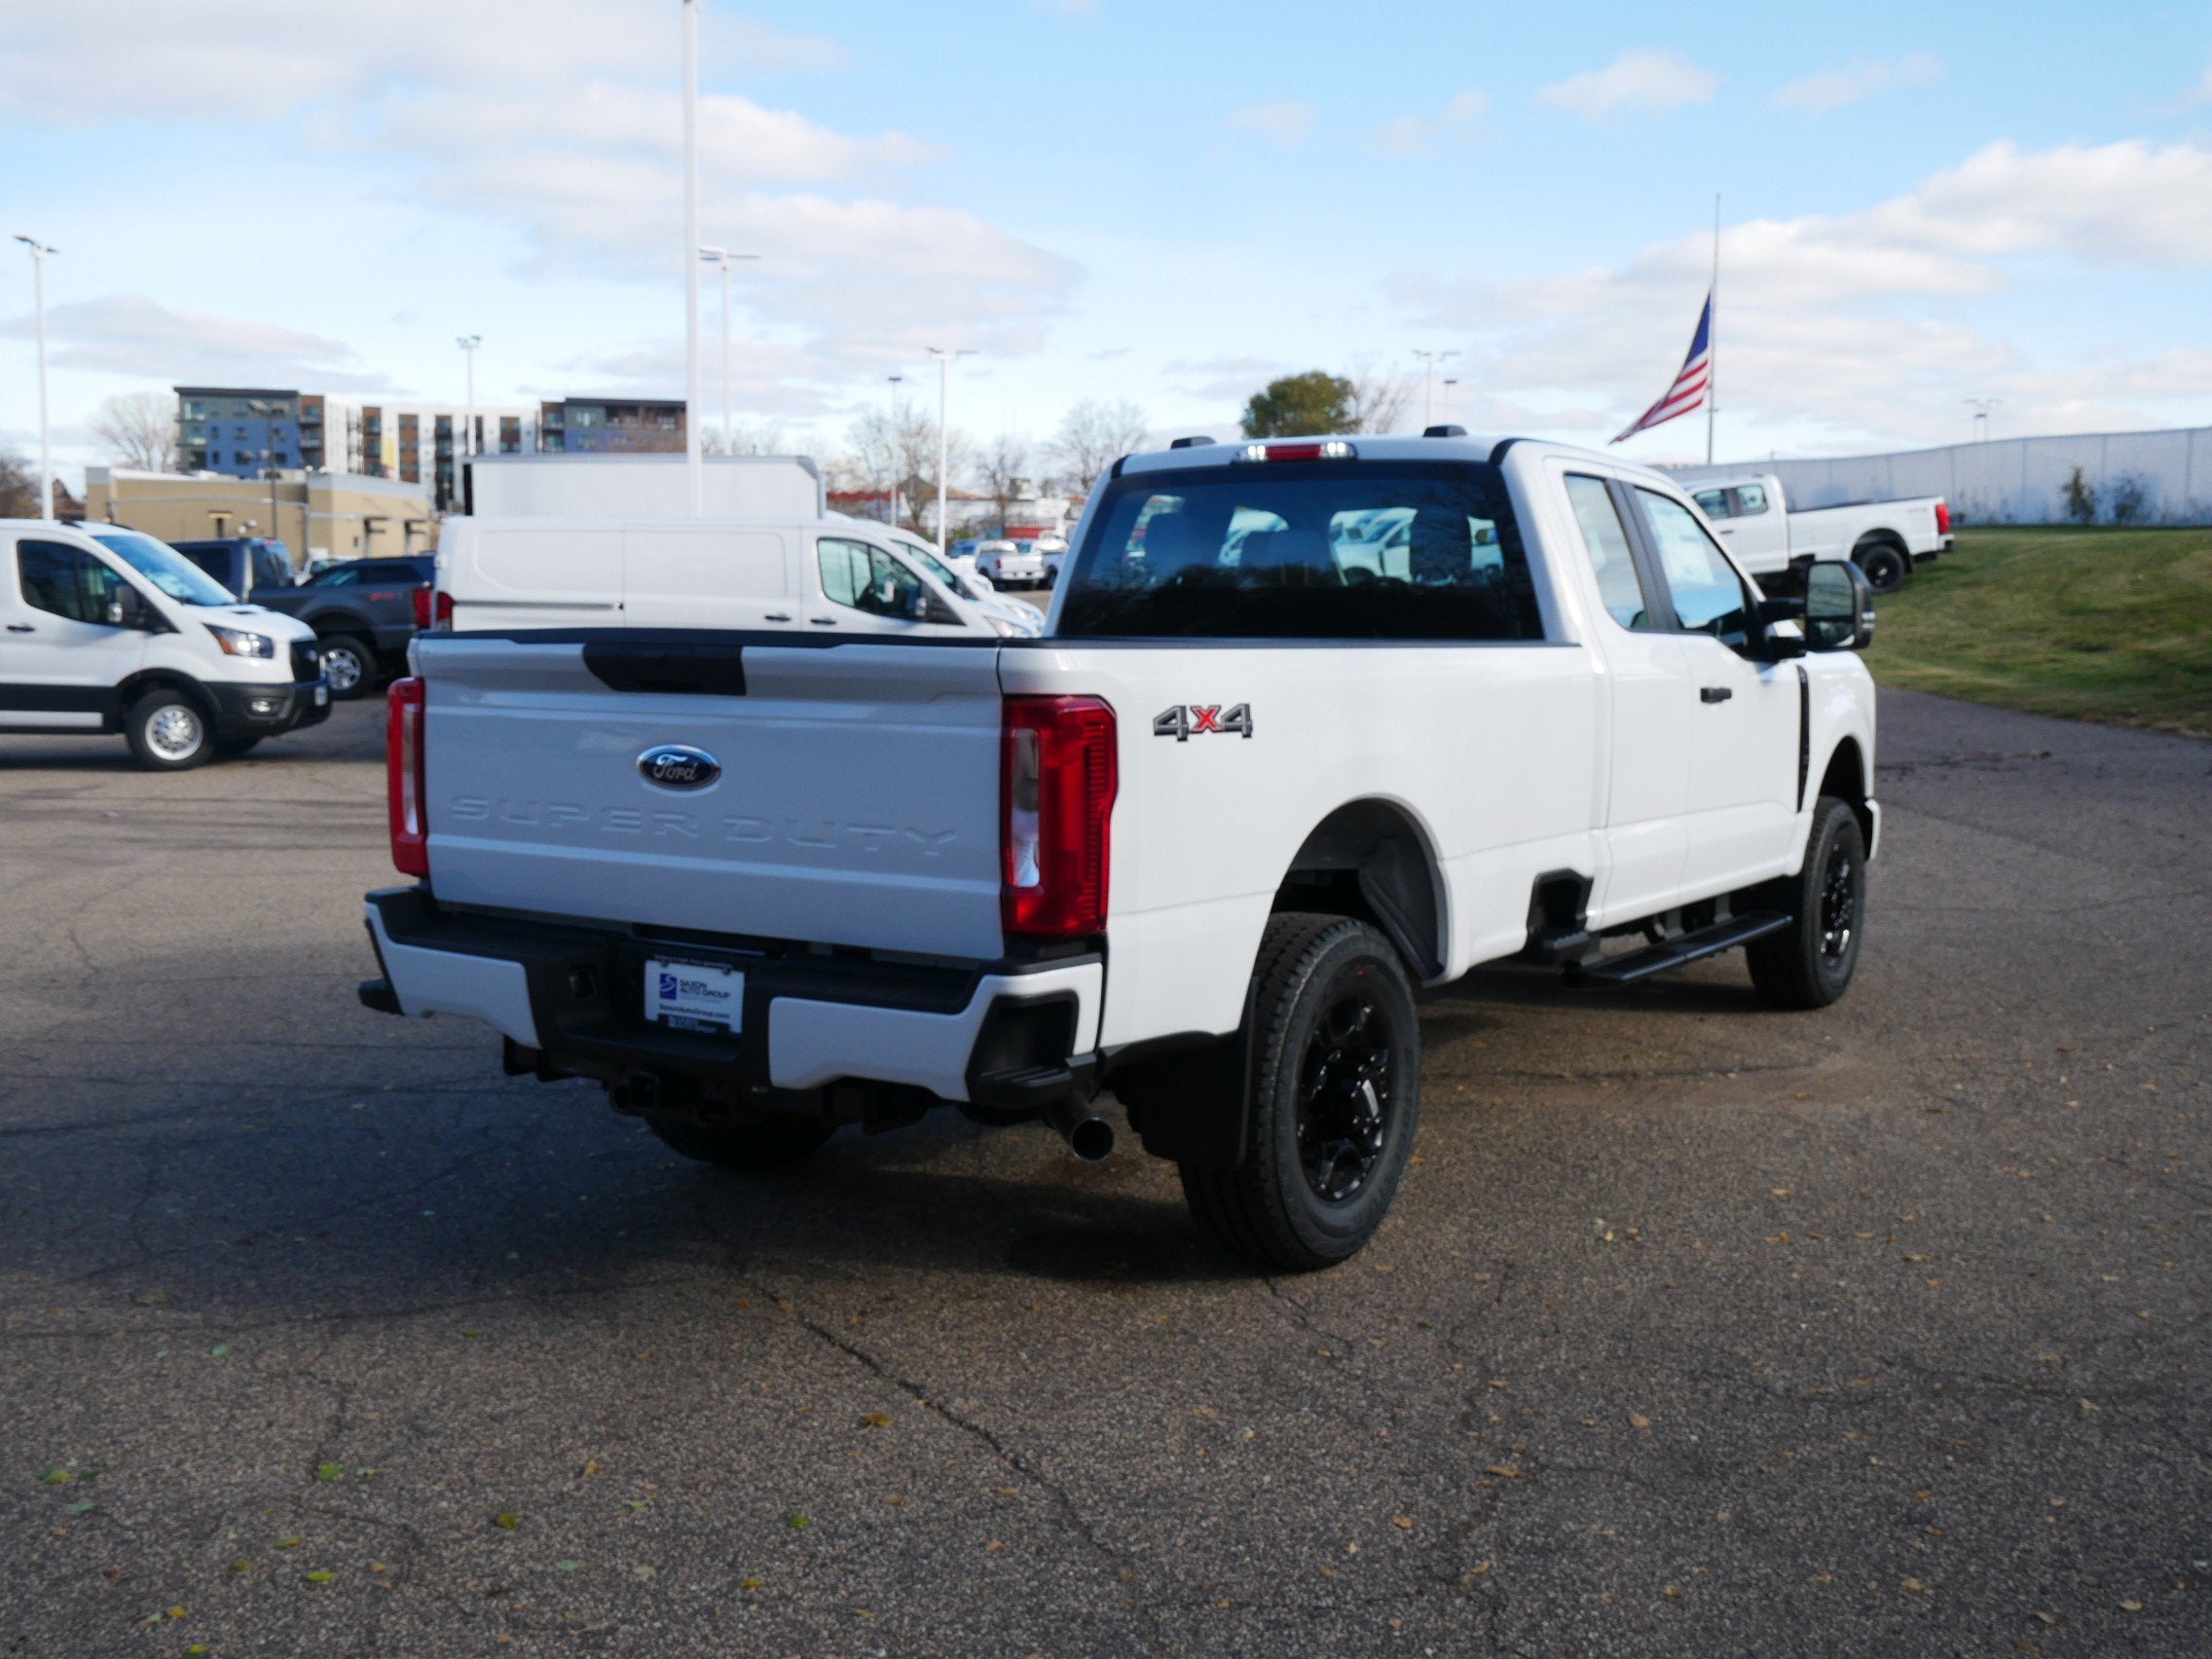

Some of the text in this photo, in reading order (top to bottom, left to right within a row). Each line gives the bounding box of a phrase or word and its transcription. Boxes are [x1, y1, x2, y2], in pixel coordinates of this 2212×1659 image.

[652, 753, 699, 781] Ford
[452, 796, 960, 857] SUPER DUTY
[680, 978, 709, 989] SAXON
[702, 988, 731, 999] GROUP
